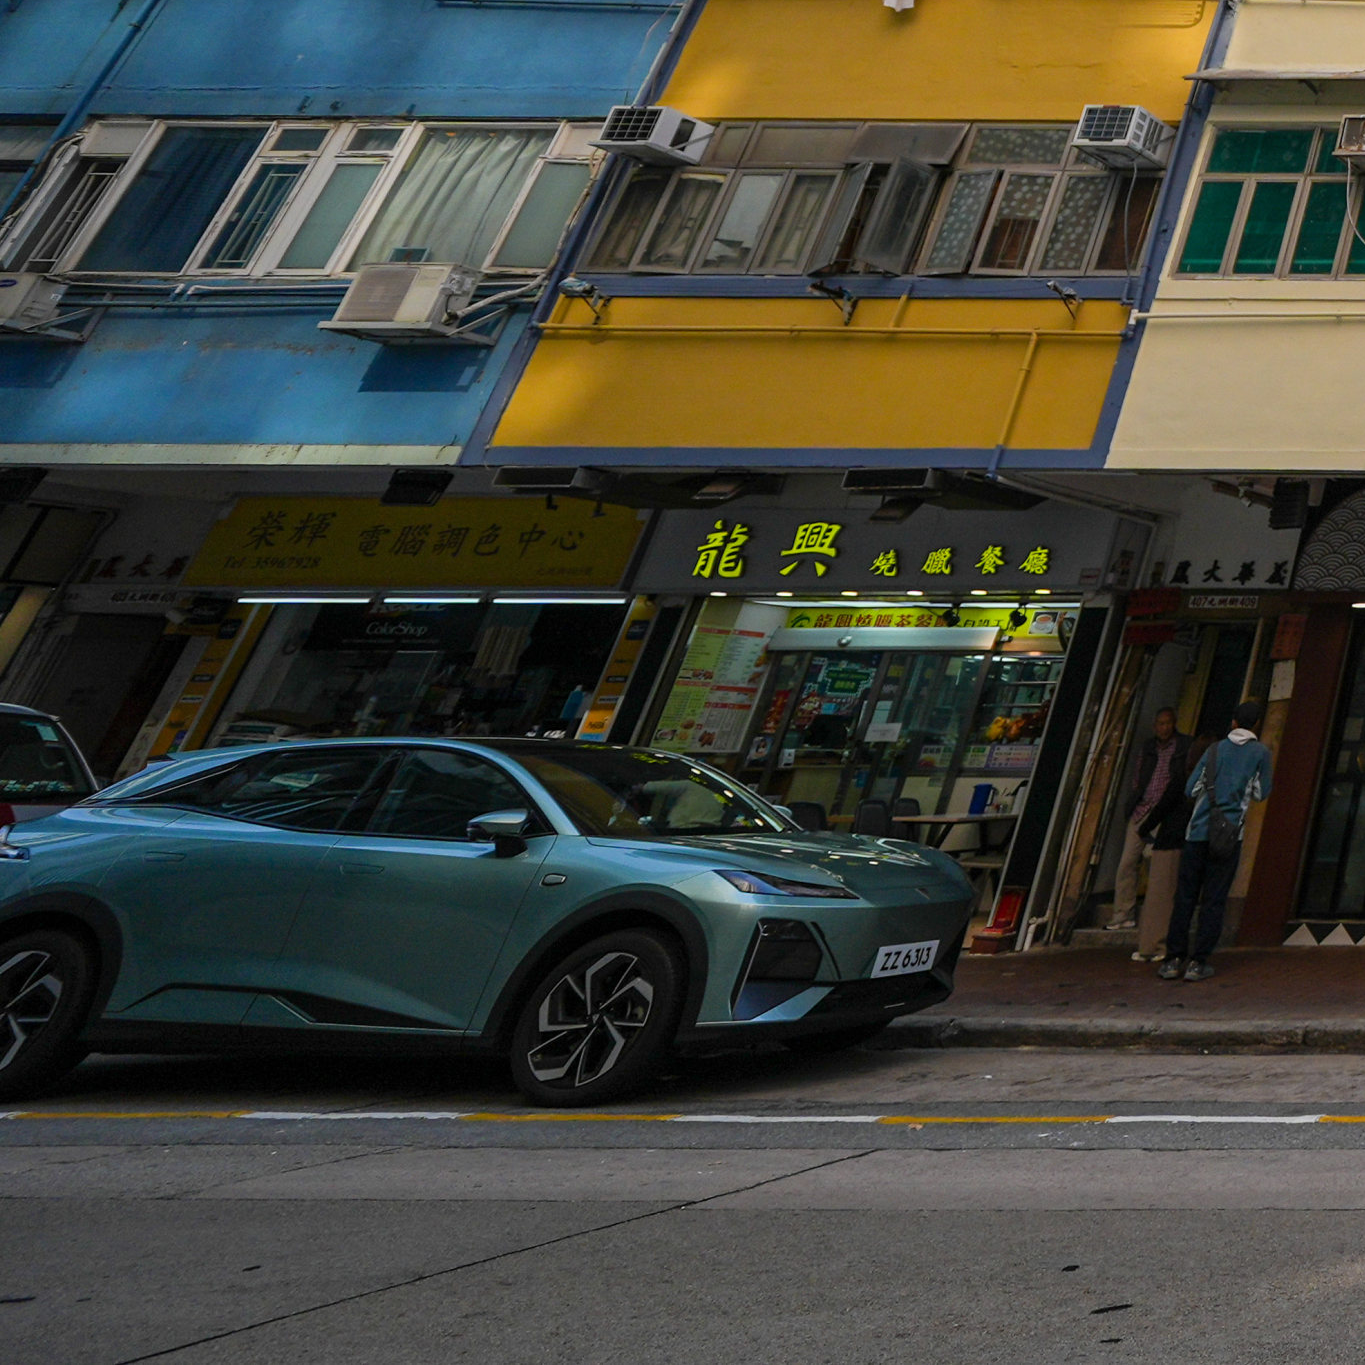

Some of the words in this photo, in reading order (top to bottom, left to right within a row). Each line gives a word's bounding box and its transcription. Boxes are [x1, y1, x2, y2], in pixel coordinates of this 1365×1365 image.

[246, 511, 339, 550] 榮輝
[691, 519, 842, 579] 龍興
[879, 950, 902, 972] ZZ
[902, 947, 932, 968] 6313
